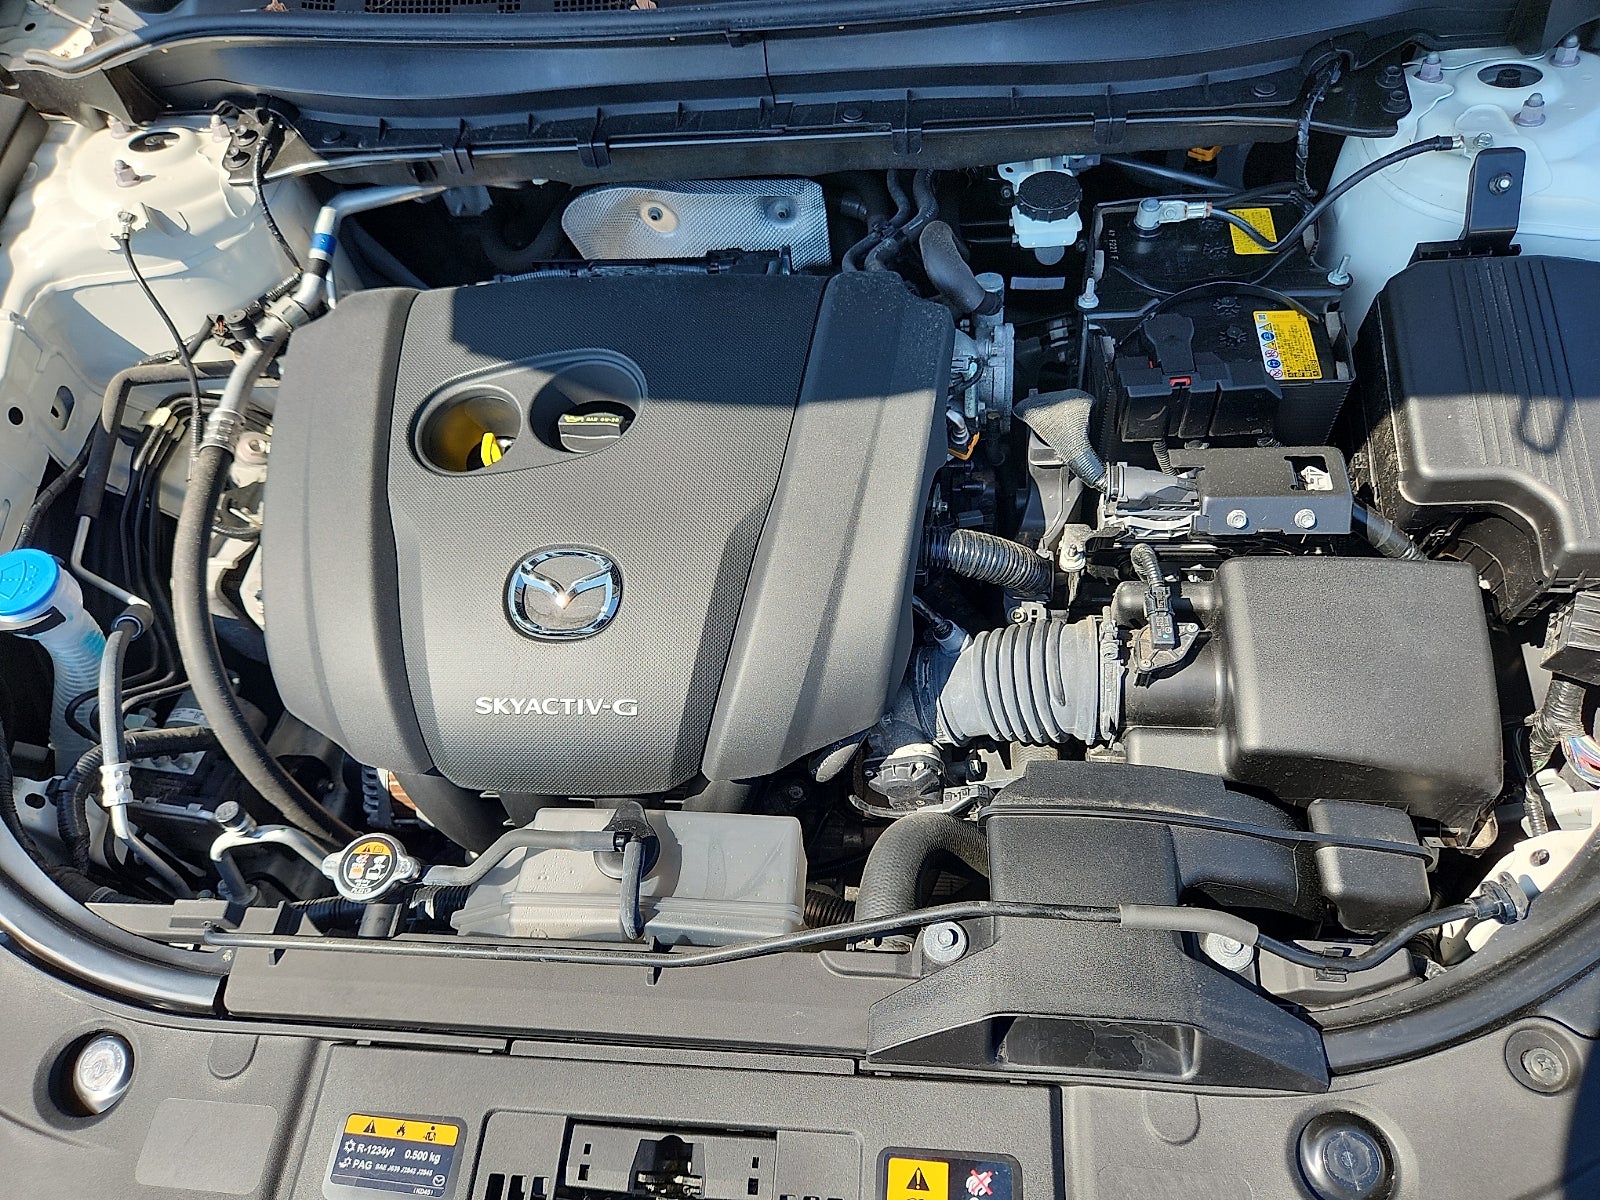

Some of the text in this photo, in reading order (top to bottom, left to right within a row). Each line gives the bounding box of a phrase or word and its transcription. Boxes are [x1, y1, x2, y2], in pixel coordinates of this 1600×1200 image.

[475, 697, 638, 716] SKYACTIV-G
[356, 1143, 441, 1165] R-1234yf 0.500 kg
[352, 1158, 373, 1170] PAG
